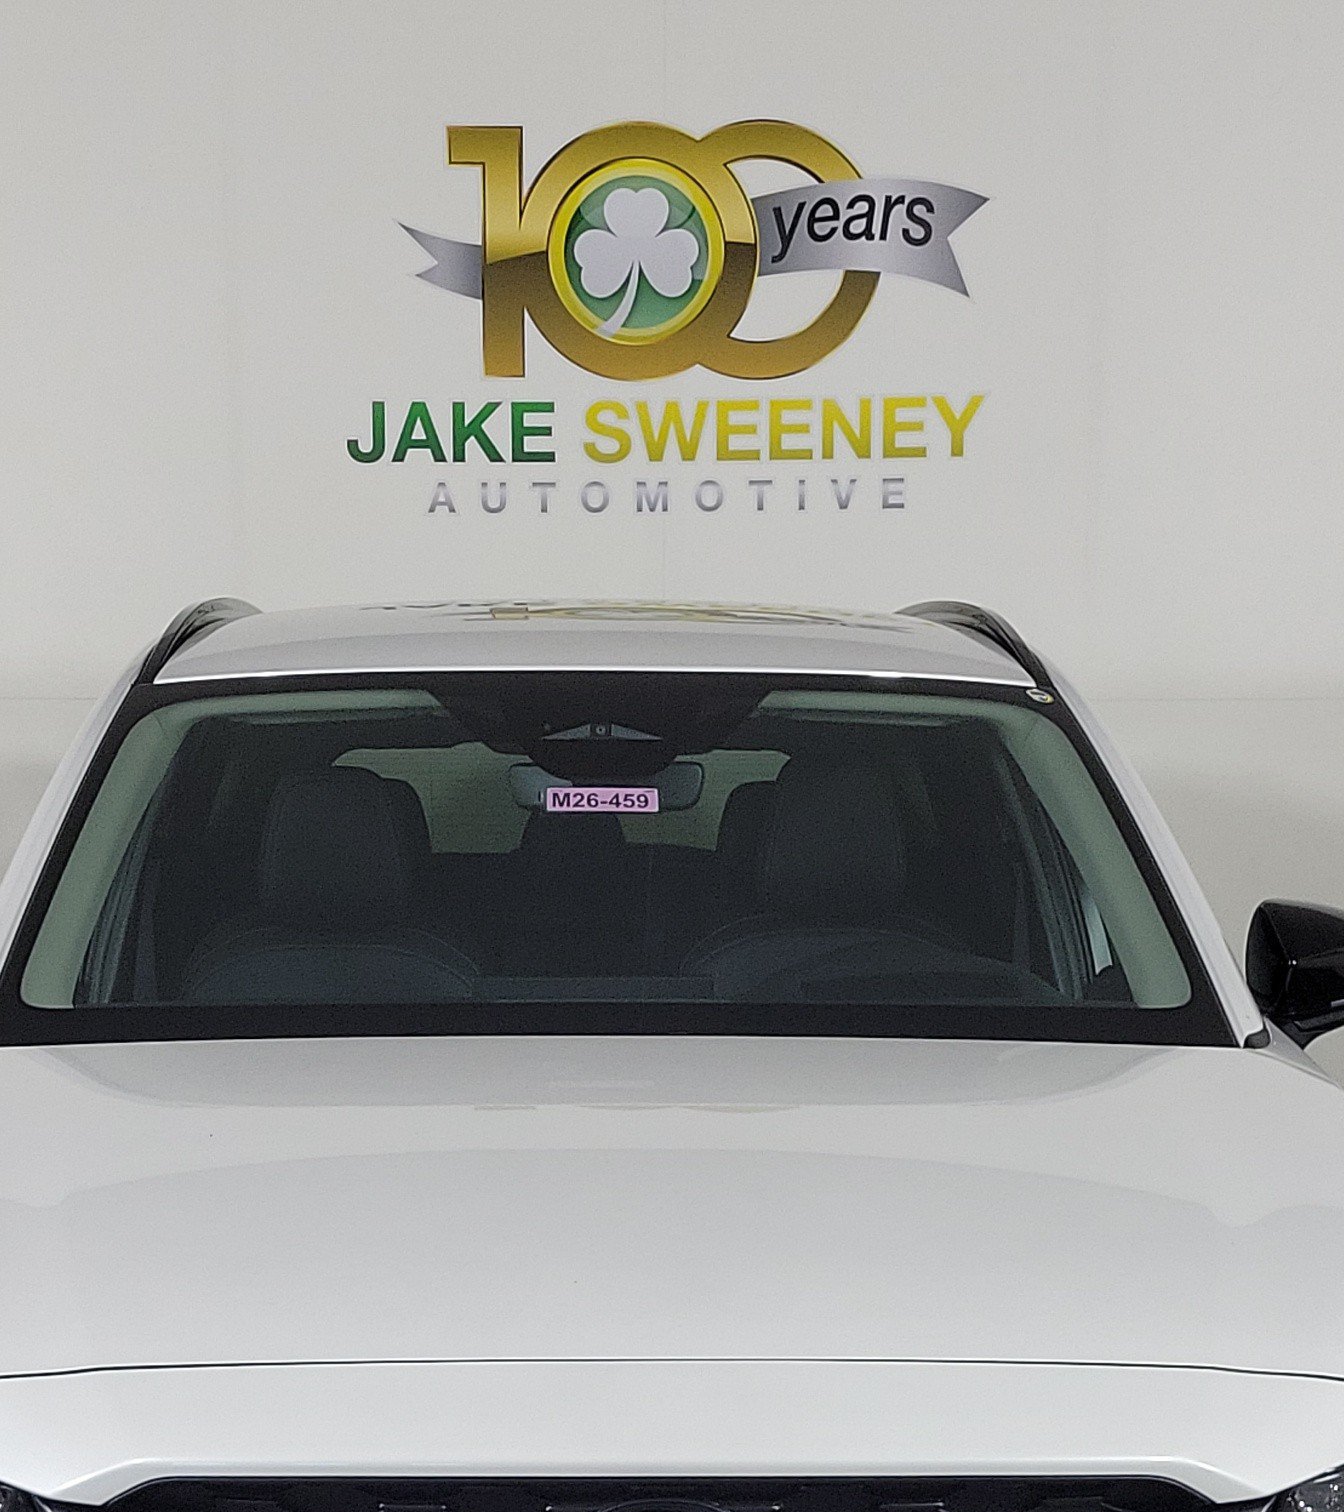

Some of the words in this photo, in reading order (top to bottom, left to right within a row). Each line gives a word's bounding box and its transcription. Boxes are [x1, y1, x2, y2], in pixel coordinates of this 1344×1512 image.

[446, 119, 881, 381] 100
[771, 193, 936, 262] years
[346, 400, 556, 463] JAKE
[582, 394, 985, 462] SWEENEY
[428, 477, 906, 514] AUTOMOTIVE
[552, 792, 649, 808] M26-459
